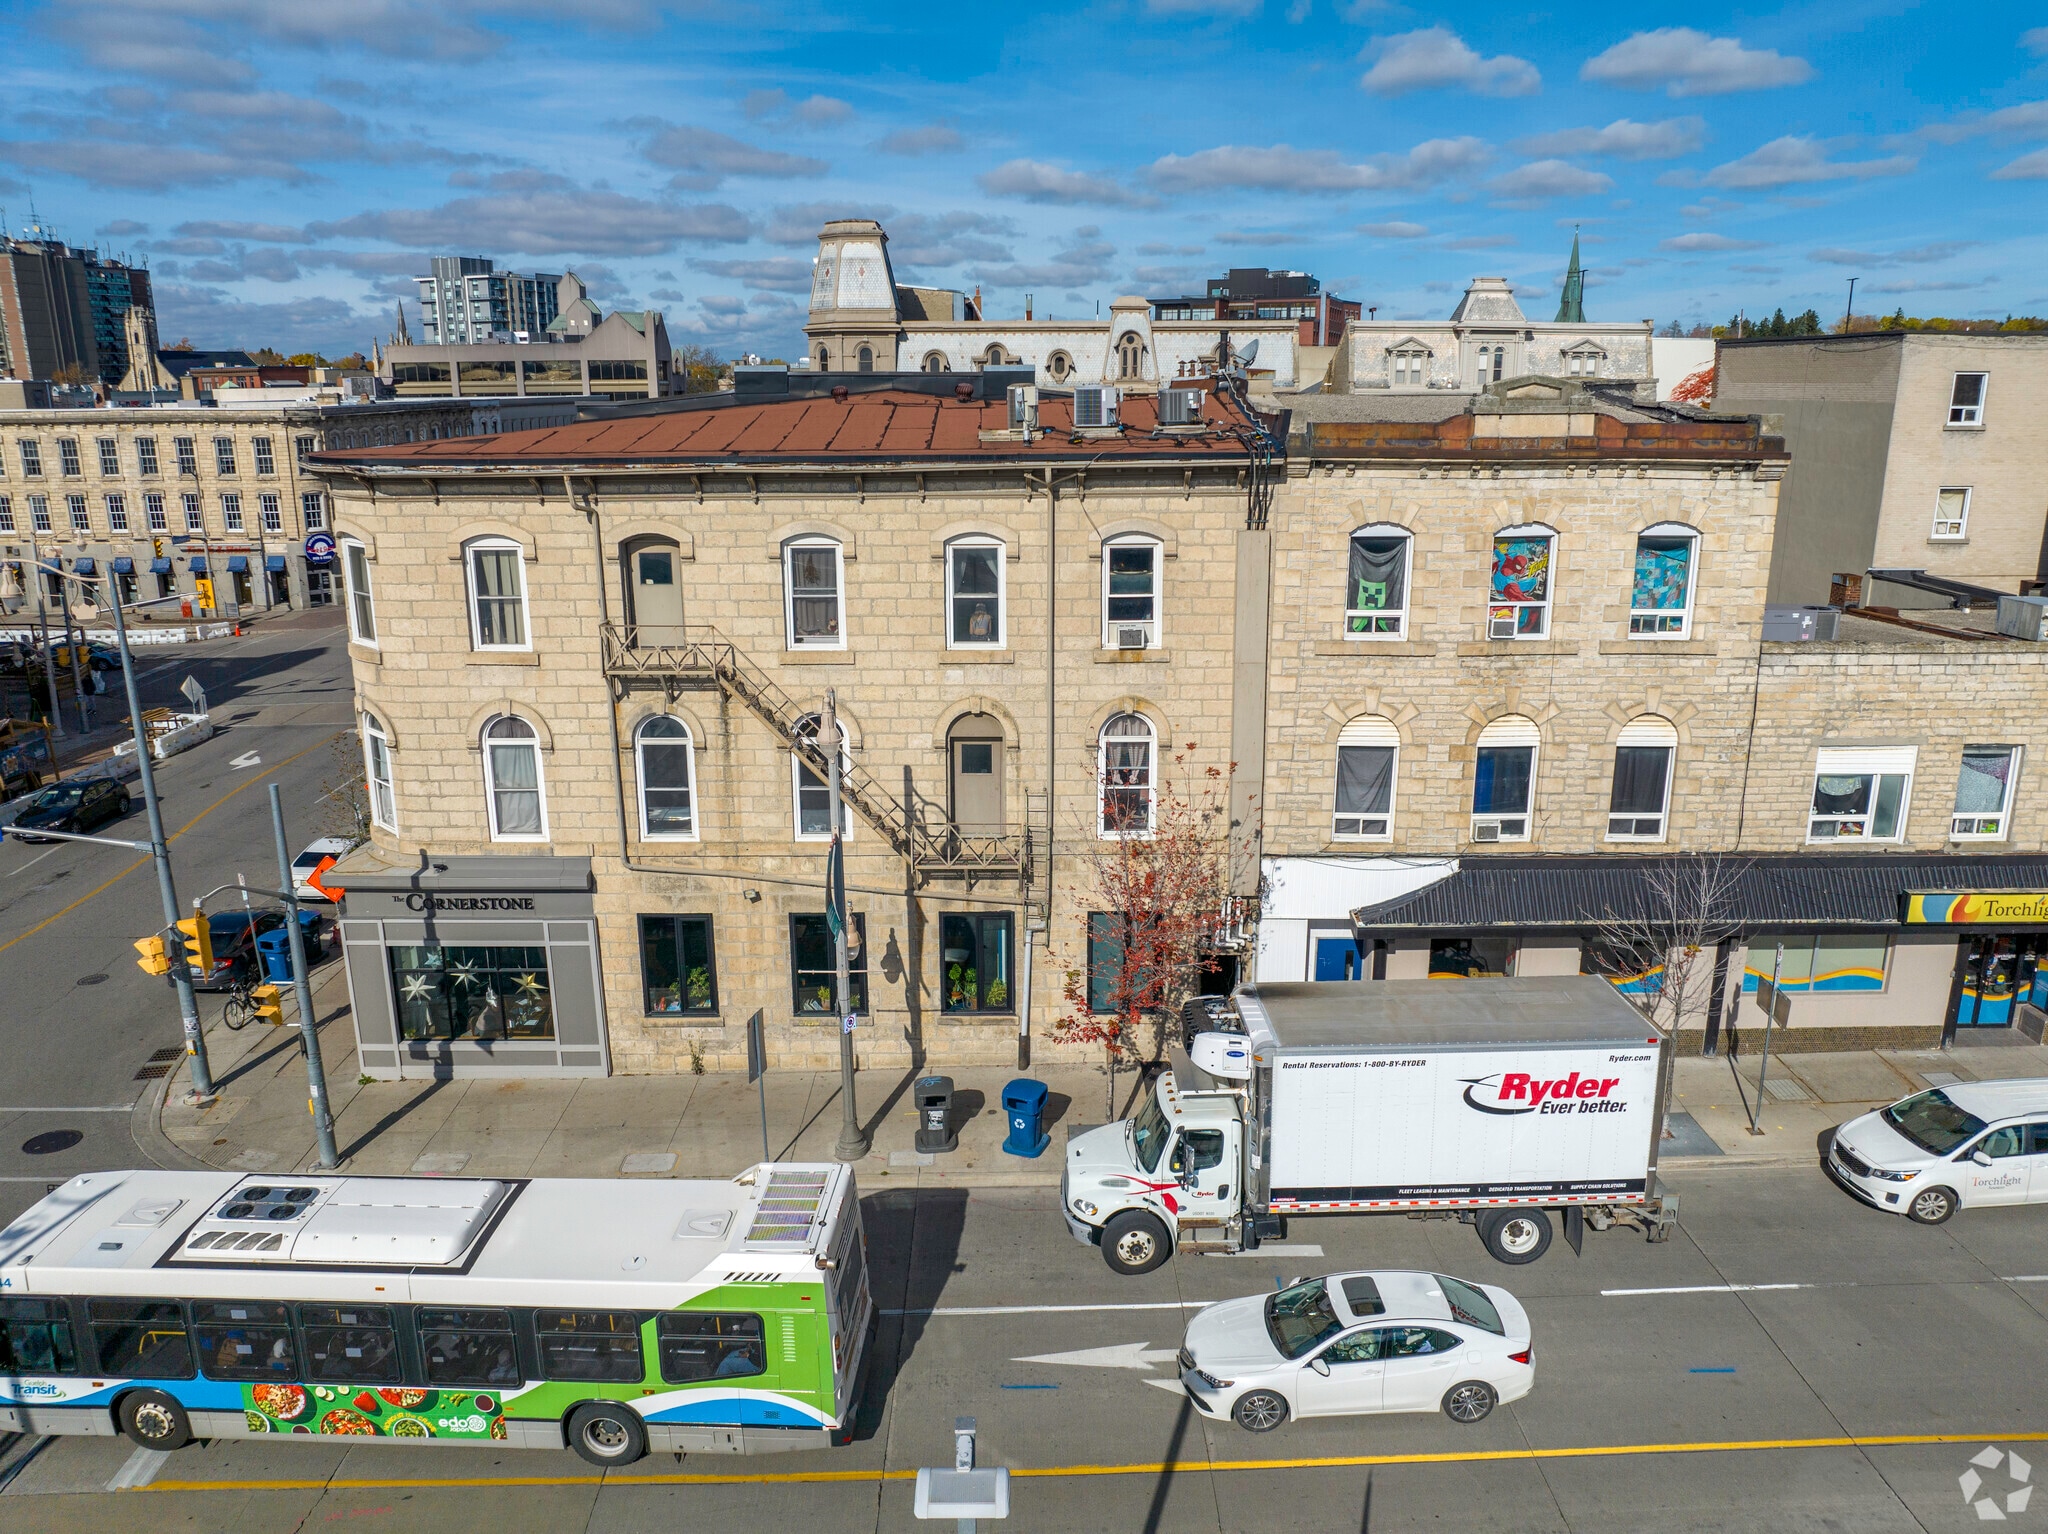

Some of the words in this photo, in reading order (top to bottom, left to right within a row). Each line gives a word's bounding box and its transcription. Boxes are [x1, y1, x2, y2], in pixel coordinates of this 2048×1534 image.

[392, 895, 405, 903] The
[405, 893, 535, 912] CORNERSTONE
[1309, 1061, 1362, 1069] Reservations:
[1363, 1060, 1427, 1068] 1-800-BY-RYDER
[1608, 1054, 1651, 1063] Ryder.com
[1498, 1072, 1620, 1107] Ryder
[1539, 1101, 1577, 1115] Ever
[1578, 1101, 1628, 1114] better.
[1972, 1175, 2022, 1187] Torchlight
[11, 1383, 58, 1395] Transit
[438, 1416, 468, 1428] edo
